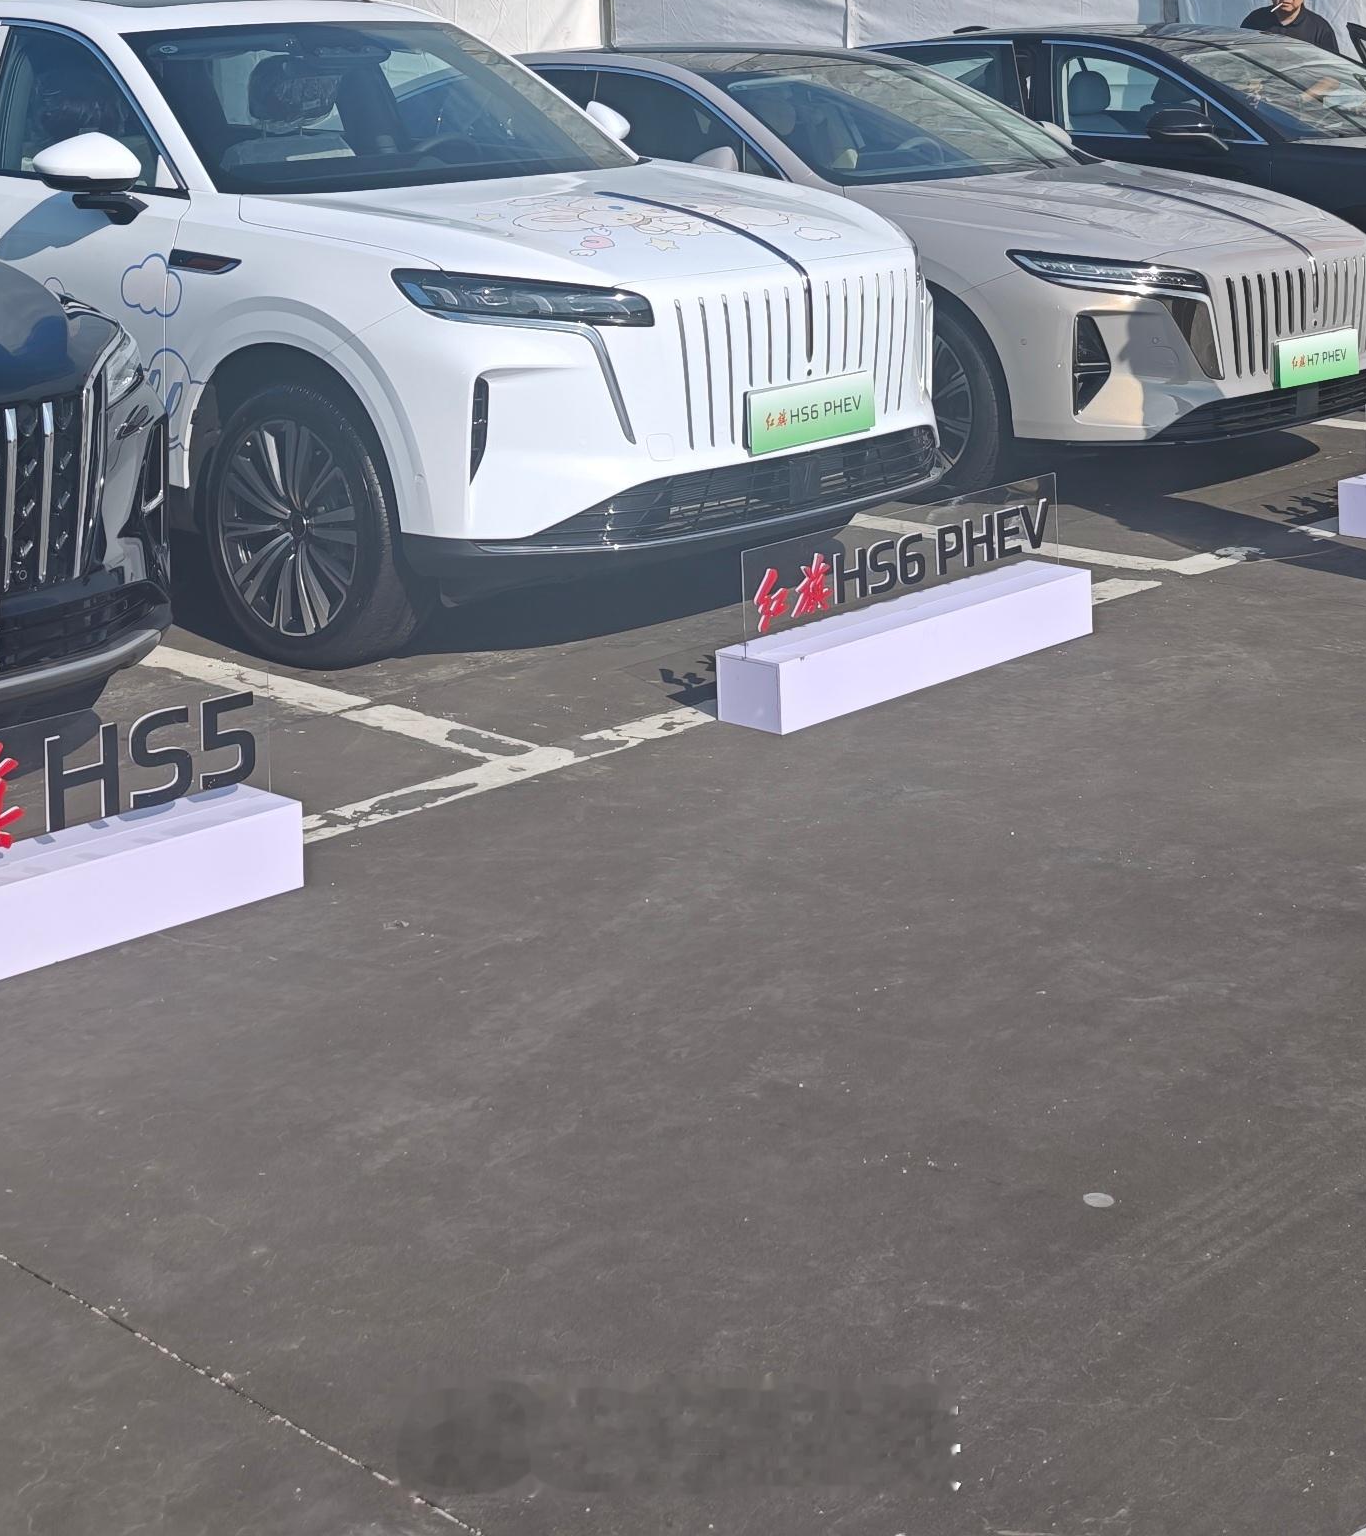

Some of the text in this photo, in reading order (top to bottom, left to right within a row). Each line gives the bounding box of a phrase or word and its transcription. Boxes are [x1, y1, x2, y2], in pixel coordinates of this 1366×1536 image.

[1322, 348, 1347, 364] PHEV
[765, 394, 862, 431] 红旗HS6 PHEV
[753, 497, 1049, 633] 红旗HS6 PHEV
